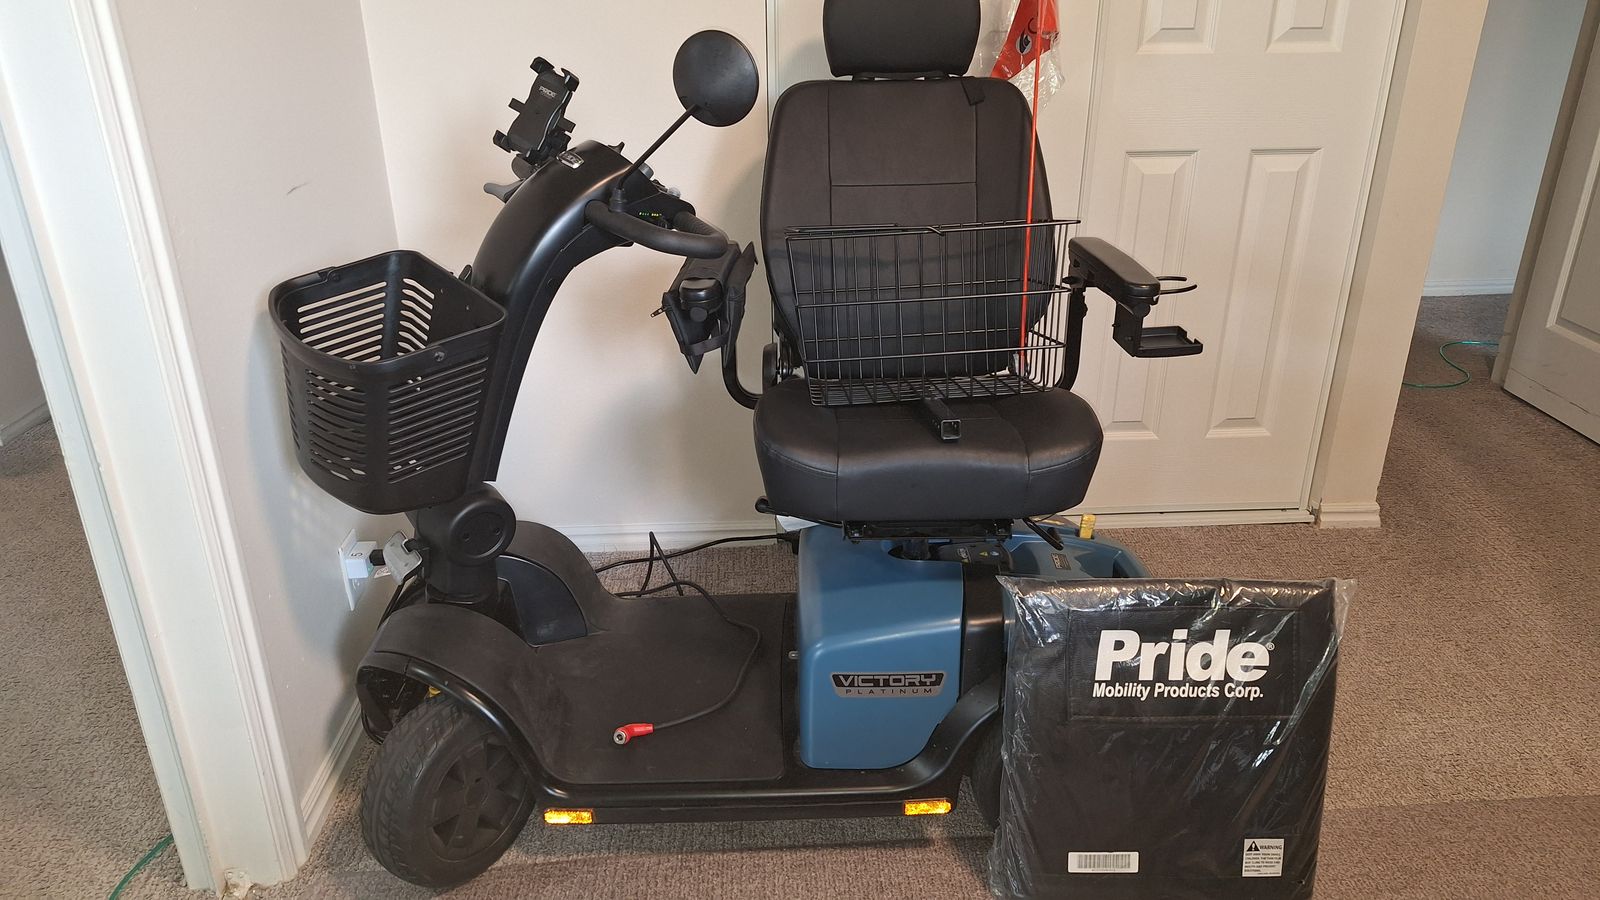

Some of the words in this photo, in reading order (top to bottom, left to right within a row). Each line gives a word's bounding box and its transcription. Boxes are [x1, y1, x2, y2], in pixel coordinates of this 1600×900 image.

[839, 675, 937, 687] VICTORY
[1092, 682, 1151, 701] Mobility
[1153, 682, 1221, 698] Products
[1223, 682, 1264, 701] Corp.
